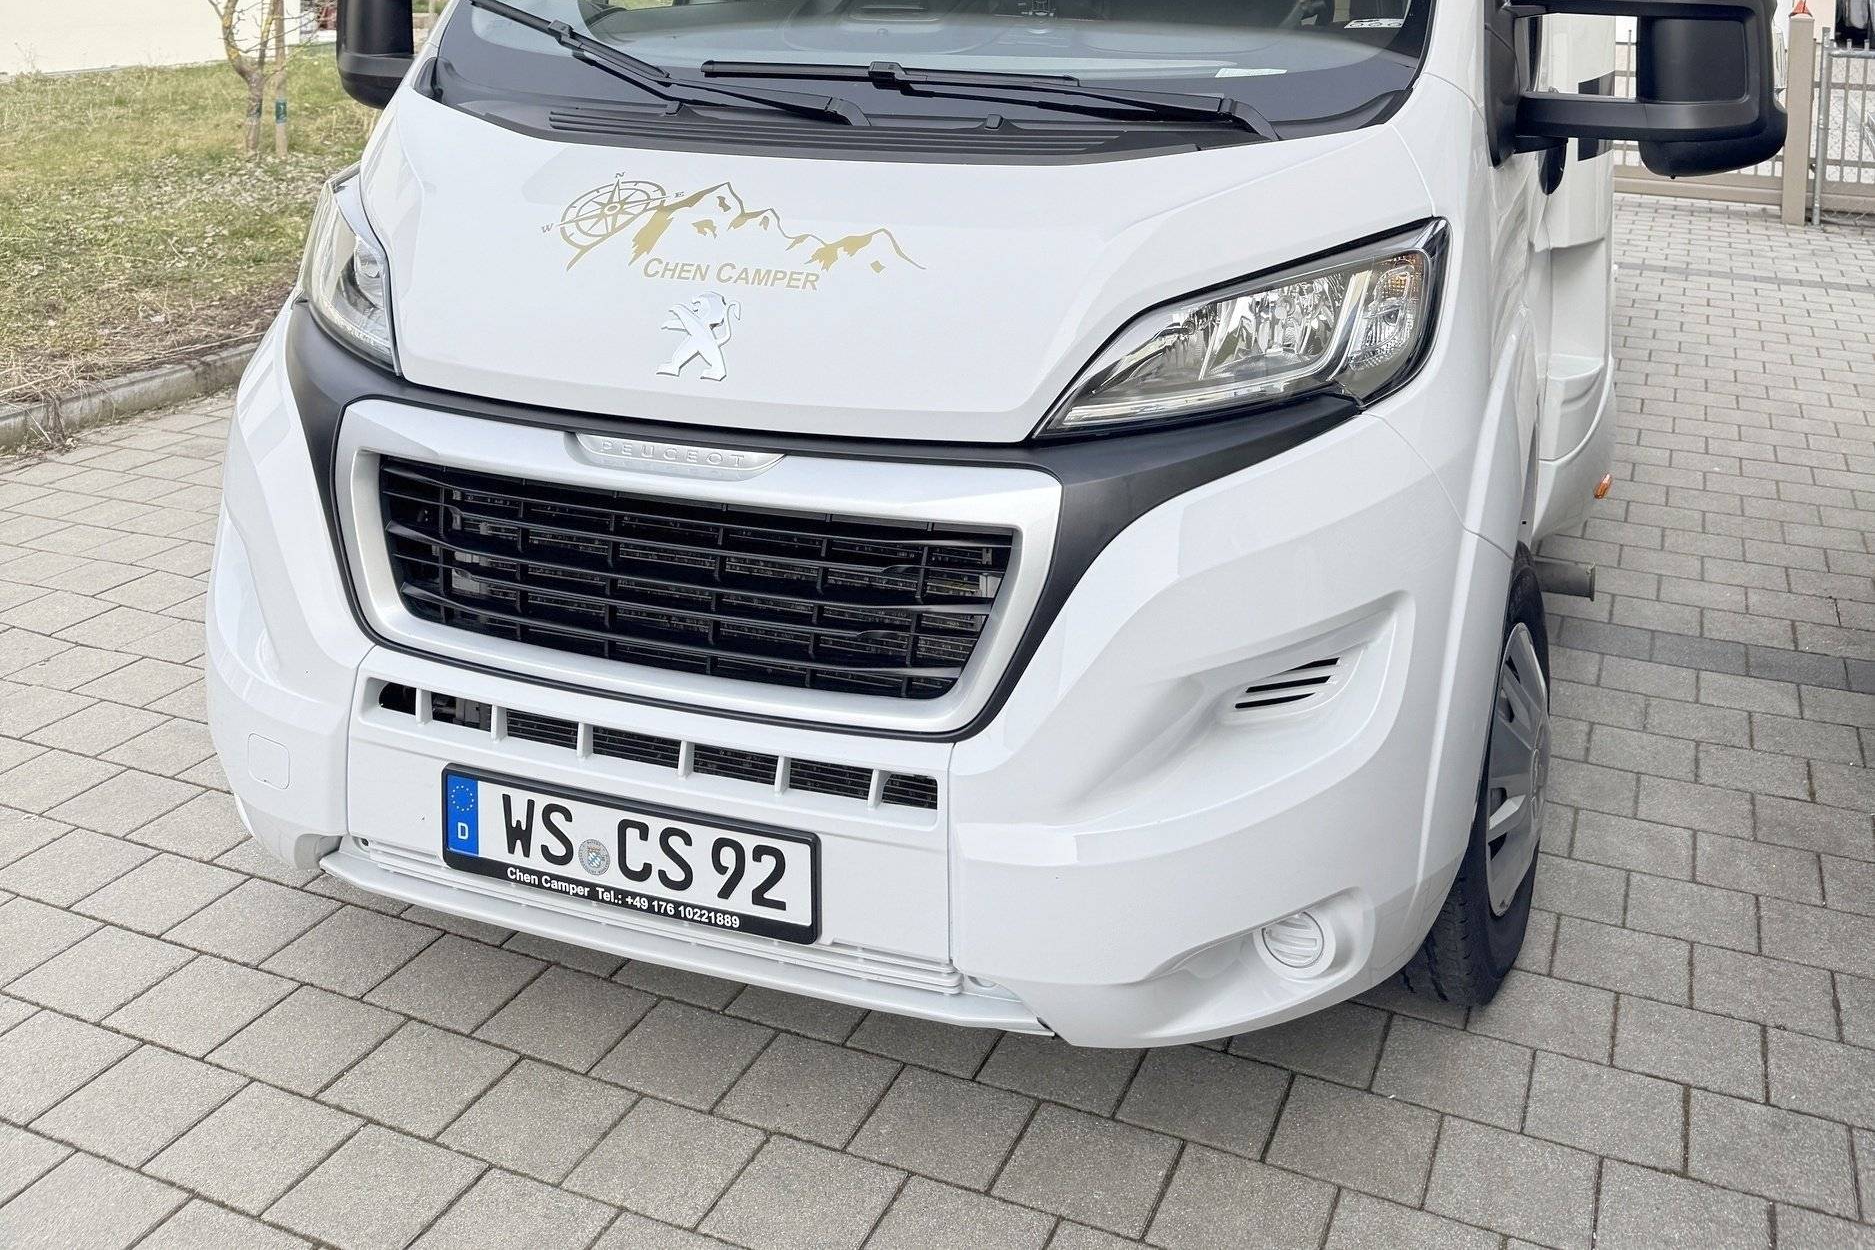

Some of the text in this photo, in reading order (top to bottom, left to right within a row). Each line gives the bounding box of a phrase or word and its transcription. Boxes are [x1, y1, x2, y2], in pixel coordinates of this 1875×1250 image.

[601, 440, 744, 467] PEUGEOT
[457, 821, 469, 840] D
[502, 793, 573, 866] WS
[617, 818, 694, 891] CS
[711, 837, 788, 911] 92
[507, 867, 740, 928] Chen Camper Tel.: +49 176 10221889
